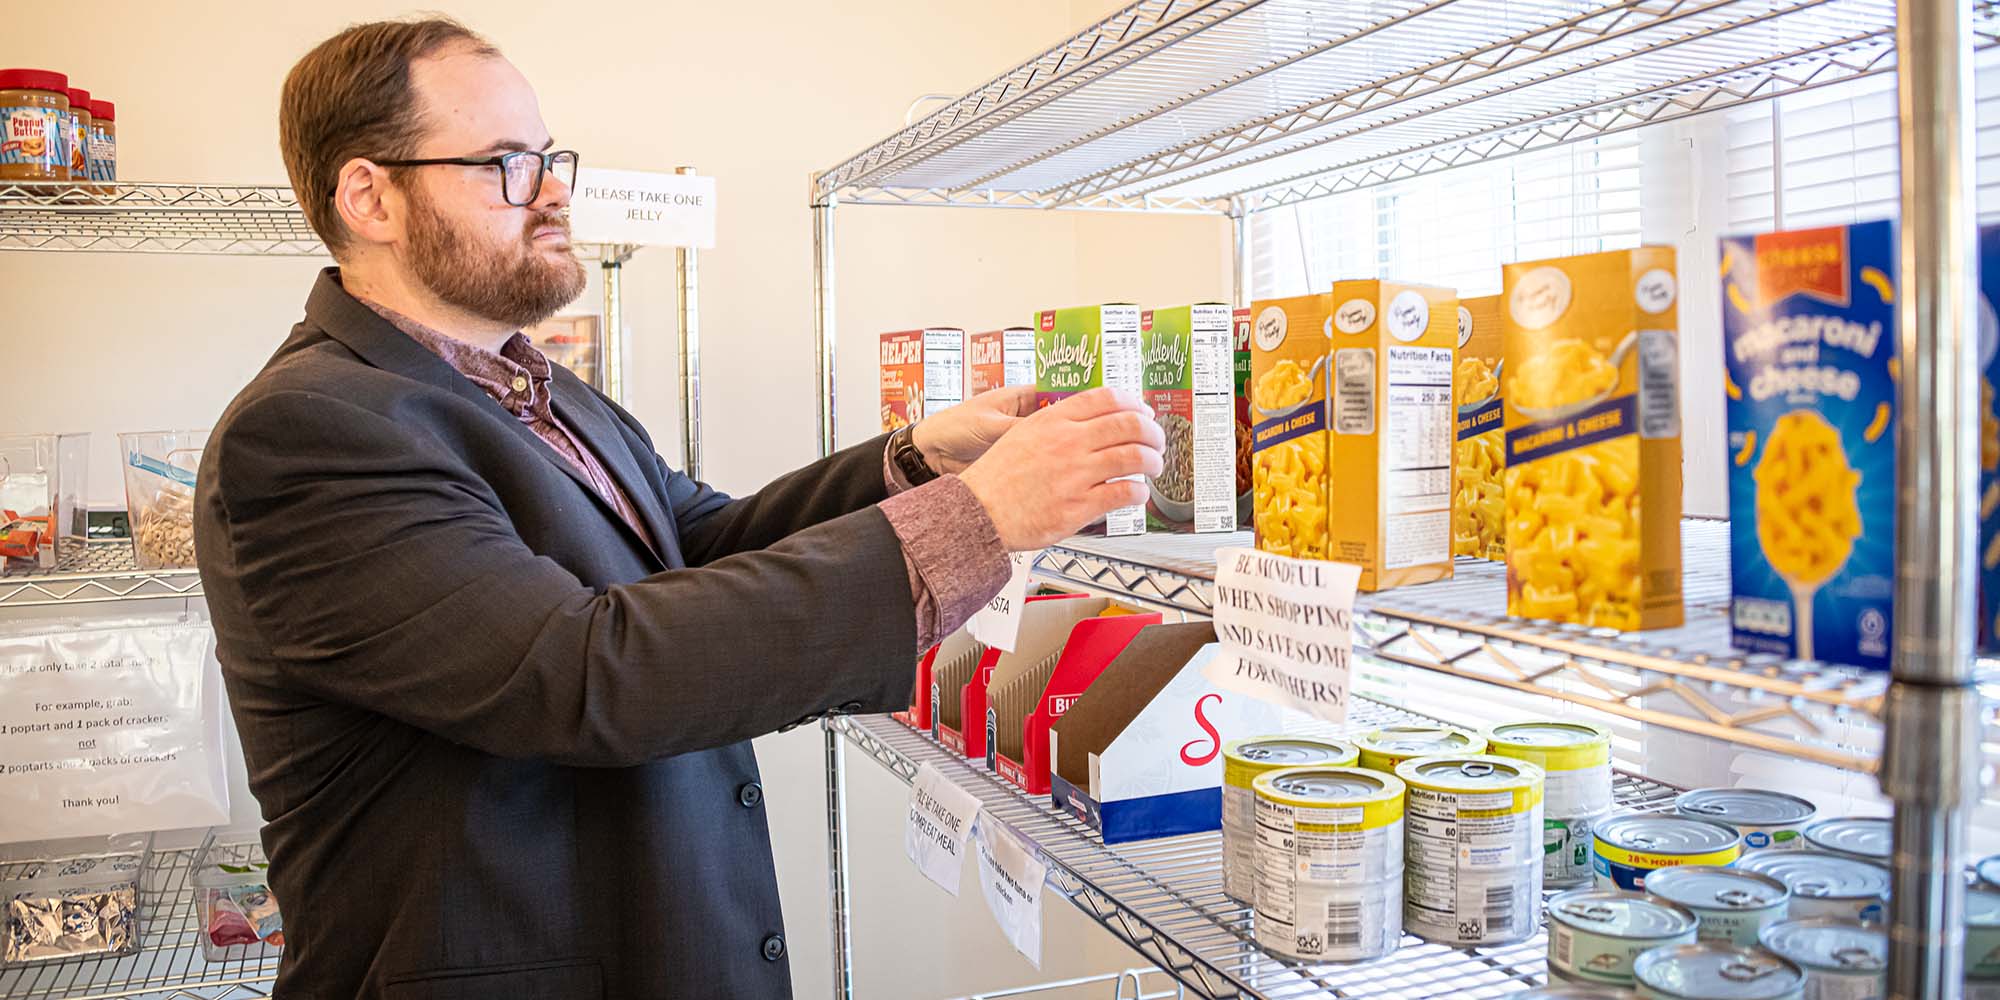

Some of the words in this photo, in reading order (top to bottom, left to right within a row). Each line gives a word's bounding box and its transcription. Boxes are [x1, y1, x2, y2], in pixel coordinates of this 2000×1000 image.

[13, 117, 44, 127] Peanut
[14, 126, 44, 136] Butter
[585, 187, 634, 201] PLEASE
[639, 191, 670, 204] TAKE
[674, 194, 703, 206] ONE
[625, 208, 662, 221] JELLY
[1734, 315, 1882, 362] macaroni
[881, 341, 921, 365] HELPER
[971, 341, 1001, 365] HELPER
[1037, 333, 1100, 384] Suddenly!
[1390, 350, 1429, 360] Nutrition
[1430, 351, 1452, 362] Facts
[1781, 345, 1819, 363] and
[1051, 372, 1080, 387] SALAD
[1149, 371, 1174, 386] SALAD
[1750, 363, 1861, 401] cheese
[1422, 393, 1435, 402] 250
[1285, 420, 1290, 432] &
[1291, 412, 1316, 431] CHEESE
[1472, 417, 1476, 426] &
[1478, 408, 1501, 424] CHEESE
[1567, 423, 1575, 439] &
[1577, 408, 1622, 436] CHEESE
[1008, 551, 1023, 565] NE
[1235, 554, 1252, 574] BE
[1255, 557, 1327, 588] MINDFUL
[988, 596, 1010, 614] ASTA
[1218, 585, 1264, 612] WHEN
[1267, 593, 1349, 631] SHOPPING
[1222, 623, 1252, 647] AND
[1256, 629, 1295, 660] SAVE
[1295, 642, 1347, 670] SOME
[39, 662, 62, 673] only
[1235, 657, 1272, 683] FOR
[1272, 670, 1344, 707] OTHERS!
[35, 702, 52, 713] For
[56, 699, 104, 711] example,
[106, 697, 132, 709] grab:
[1, 725, 7, 734] 1
[11, 723, 50, 735] poptart
[54, 720, 73, 731] and
[77, 720, 82, 729] 1
[86, 717, 110, 729] pack
[113, 716, 123, 726] of
[1180, 694, 1222, 766] S
[78, 739, 96, 749] not
[0, 764, 5, 774] 2
[8, 760, 53, 774] poptarts
[88, 755, 118, 769] packs
[62, 797, 93, 808] Thank
[96, 795, 119, 808] you!
[1410, 788, 1435, 801] Nutrition
[1437, 793, 1456, 803] Facts
[931, 800, 946, 821] TAKE
[945, 812, 961, 833] ONE
[1273, 803, 1293, 816] Facts
[910, 808, 937, 840] COMPLEAT
[936, 831, 956, 856] MEAL
[1445, 828, 1456, 837] 60
[1283, 839, 1293, 848] 60
